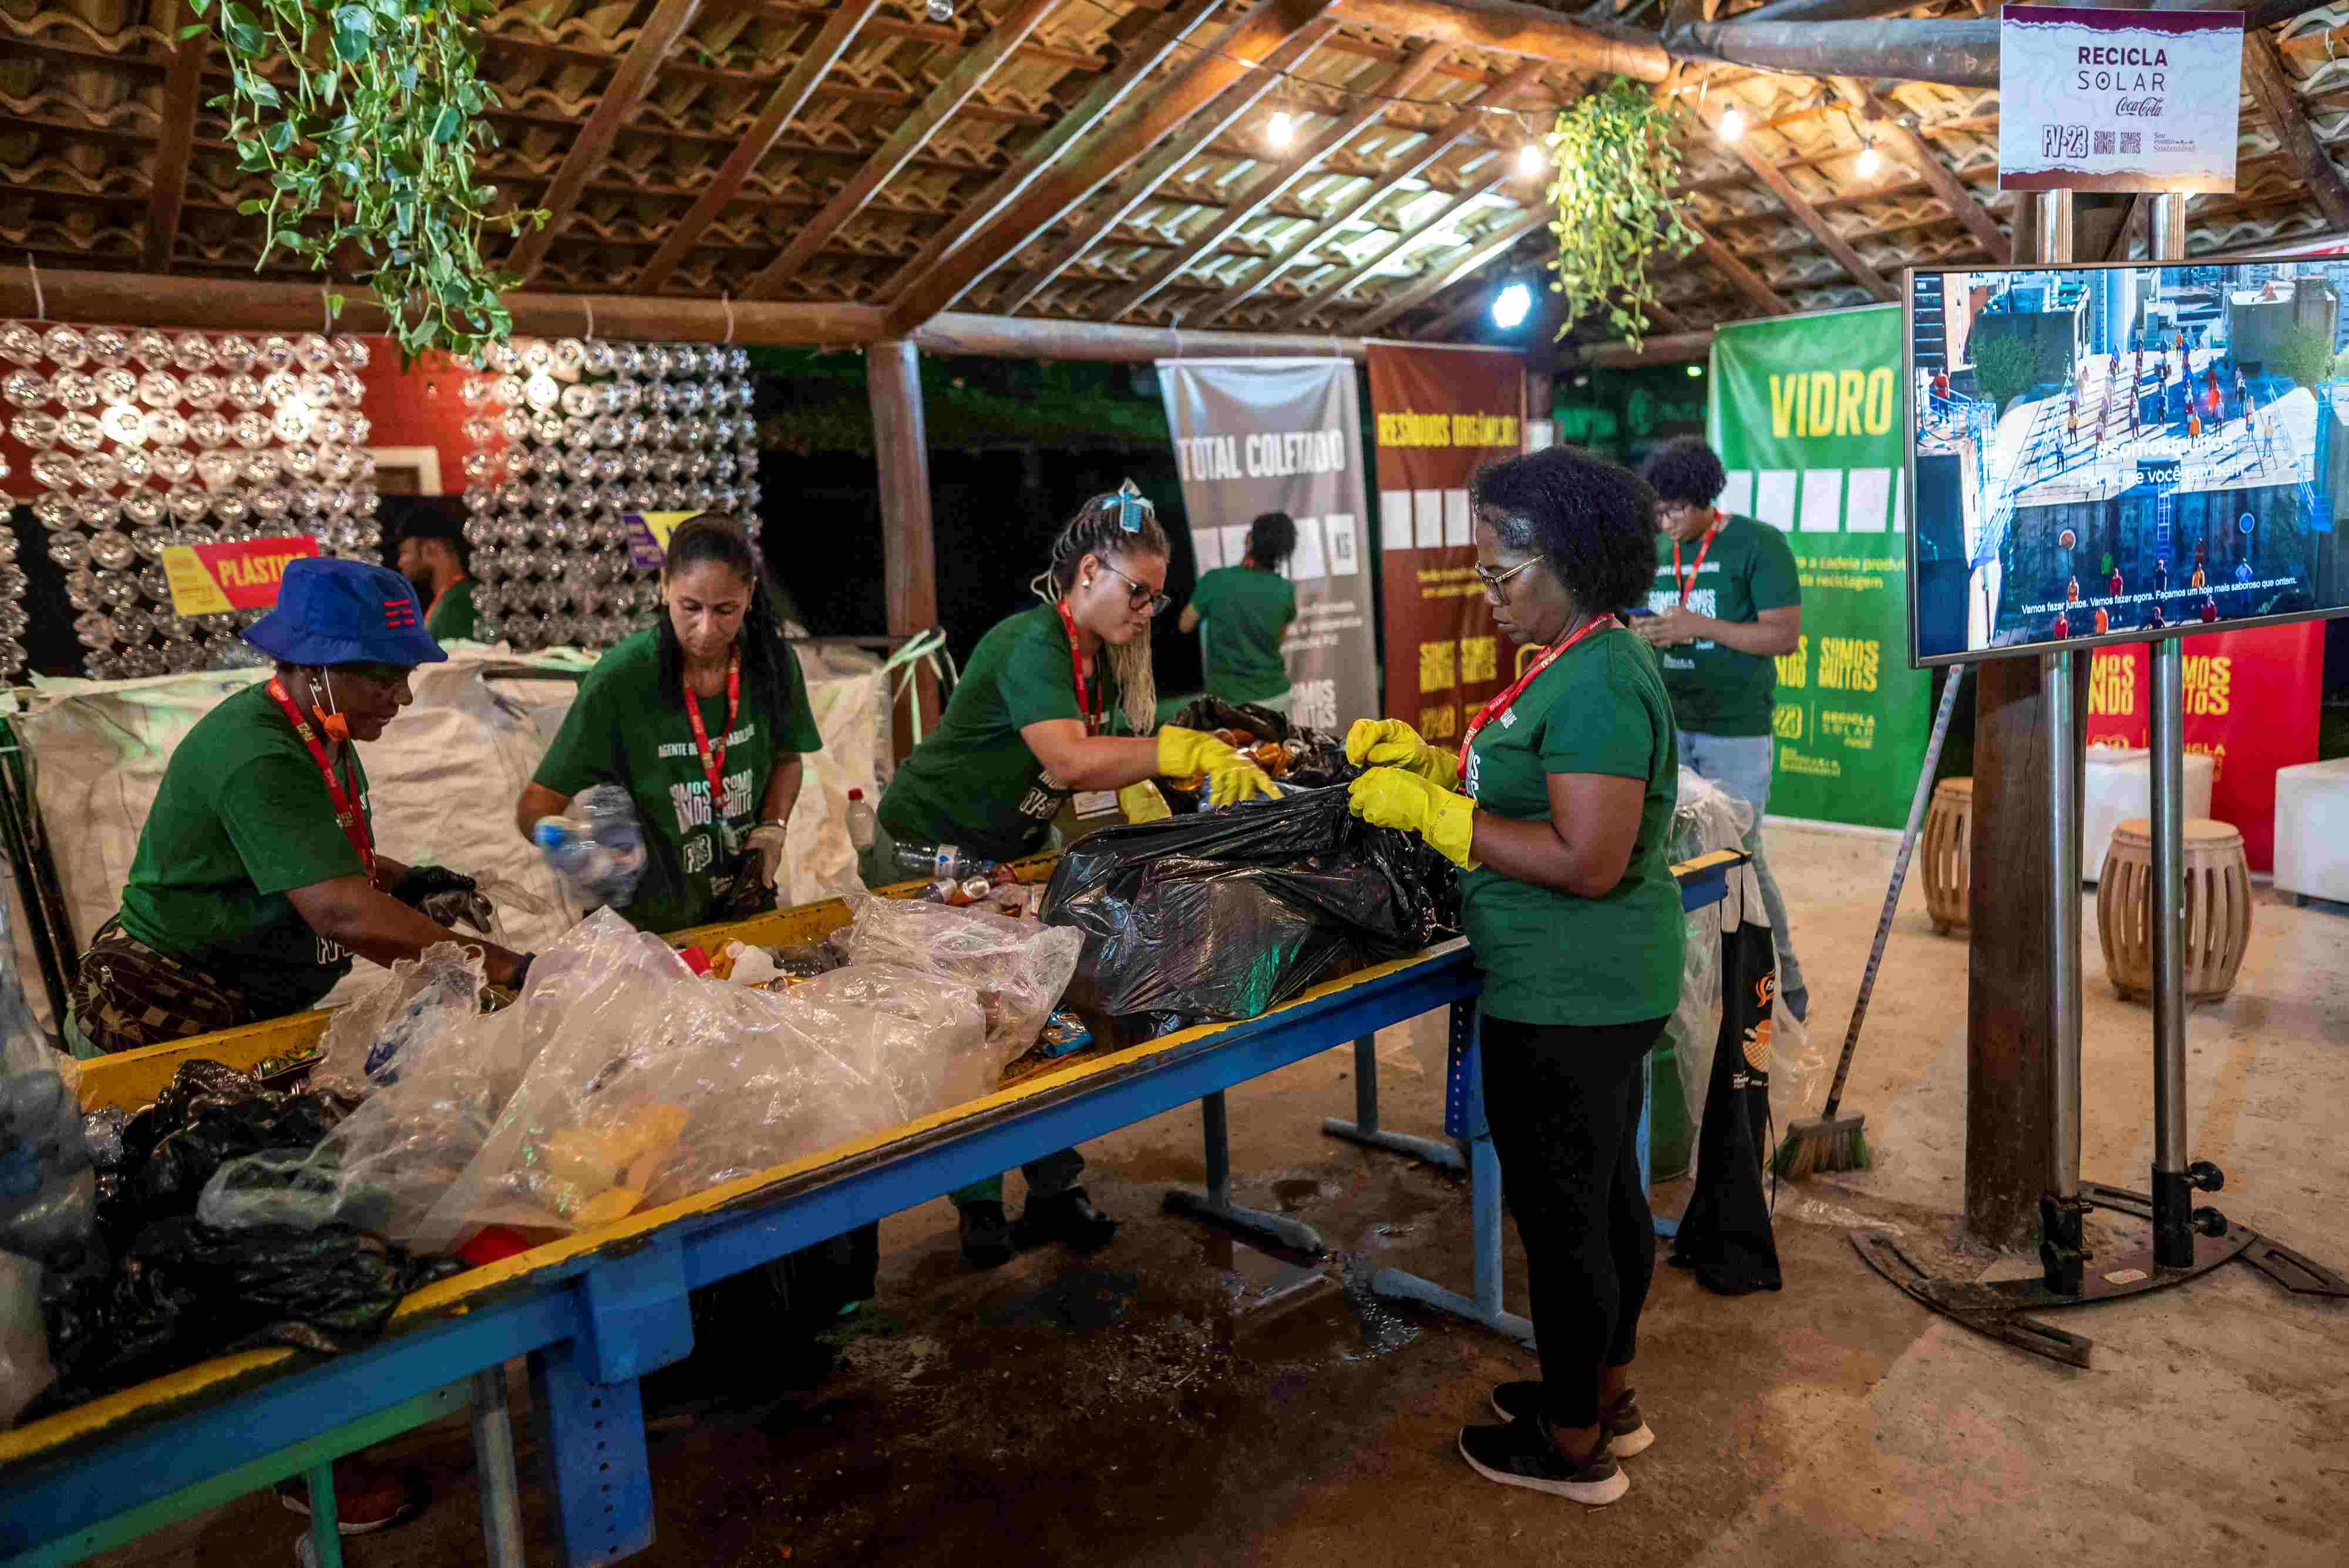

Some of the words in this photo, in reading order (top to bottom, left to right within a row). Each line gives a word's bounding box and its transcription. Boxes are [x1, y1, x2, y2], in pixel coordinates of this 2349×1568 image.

[2078, 46, 2168, 66] RECICLA
[2078, 70, 2165, 92] SOLAR
[2115, 96, 2165, 117] Coca-Cola
[1768, 366, 1896, 438] VIDRO
[1176, 434, 1242, 483] TOTAL
[1245, 429, 1346, 479] COLETADO
[2147, 465, 2181, 483] você
[2021, 604, 2045, 615] Vamos
[2047, 601, 2064, 612] fazer
[2065, 600, 2089, 612] juntos.
[2090, 597, 2114, 607] Vamos
[2115, 594, 2131, 604] fazer
[2133, 593, 2154, 604] agora.
[2156, 589, 2186, 601] Façamos
[2187, 588, 2197, 597] um
[2199, 586, 2213, 597] hoje
[2214, 583, 2230, 593] mais
[2231, 580, 2260, 591] saboroso
[2261, 580, 2274, 589] que
[2275, 577, 2297, 587] ontem.
[658, 742, 688, 758] AGENTE
